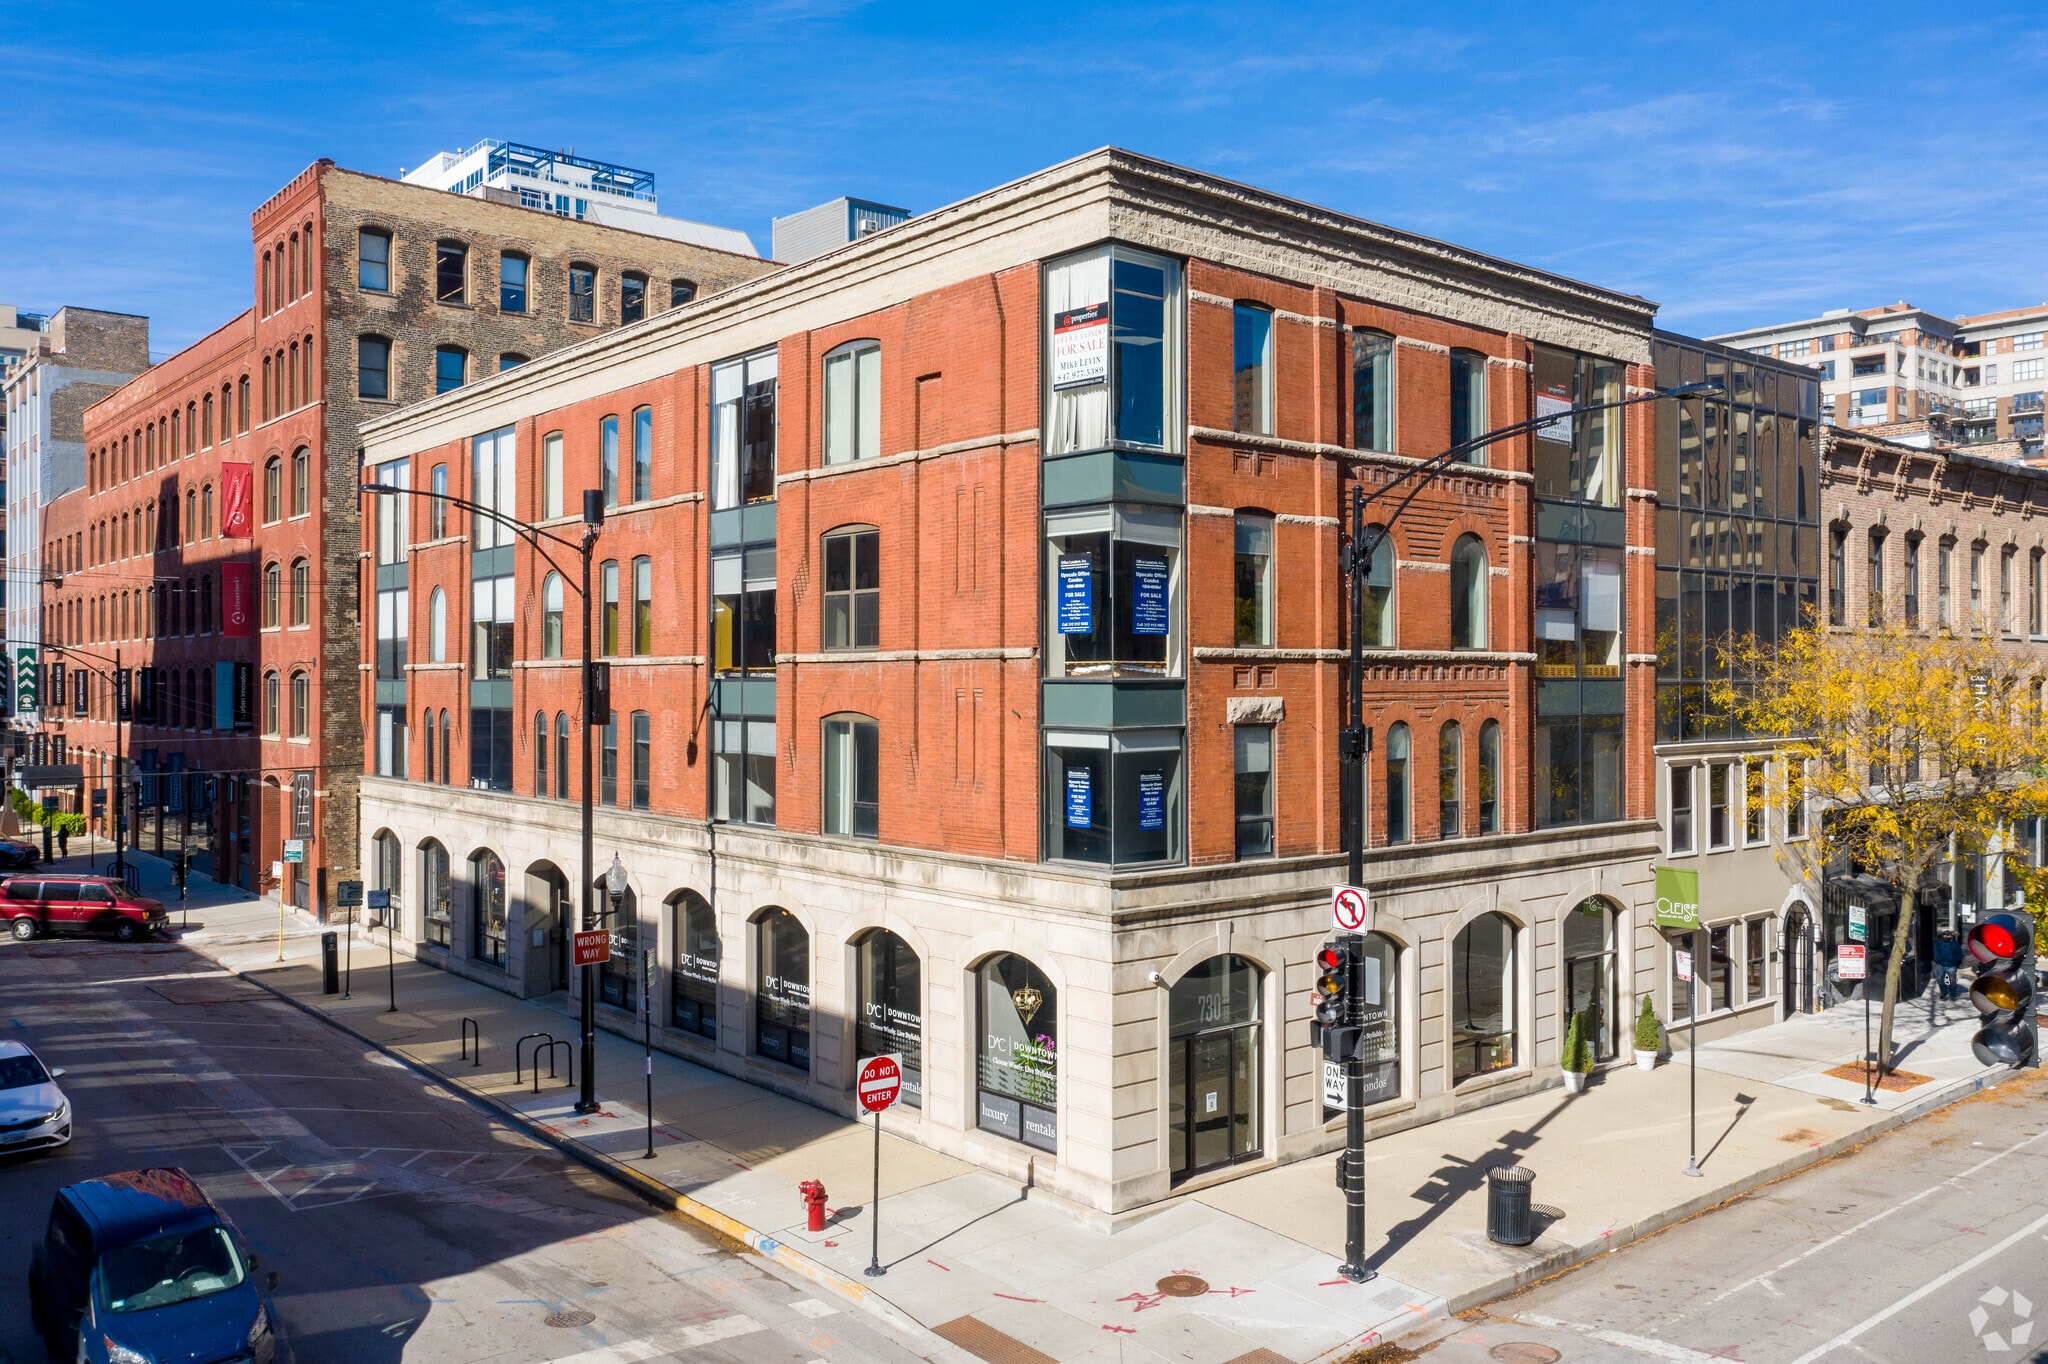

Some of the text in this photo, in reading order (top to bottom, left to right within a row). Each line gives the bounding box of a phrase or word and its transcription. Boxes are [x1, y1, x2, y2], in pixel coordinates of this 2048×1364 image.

[1057, 337, 1105, 357] FOR SALE
[577, 934, 607, 947] WRONG
[582, 948, 600, 960] WAY
[1198, 992, 1221, 1023] 730
[887, 1008, 921, 1023] DOWNTOW
[1363, 1010, 1388, 1021] NTOWN
[791, 1045, 810, 1058] rental
[992, 1056, 1009, 1067] Choose
[864, 1064, 896, 1079] DO NOT
[1325, 1065, 1345, 1080] ONE
[901, 1080, 922, 1095] entals
[1325, 1077, 1345, 1092] WAY
[1363, 1077, 1388, 1093] ondos
[867, 1090, 892, 1104] ENTER
[982, 1103, 1056, 1138] luxury rentals
